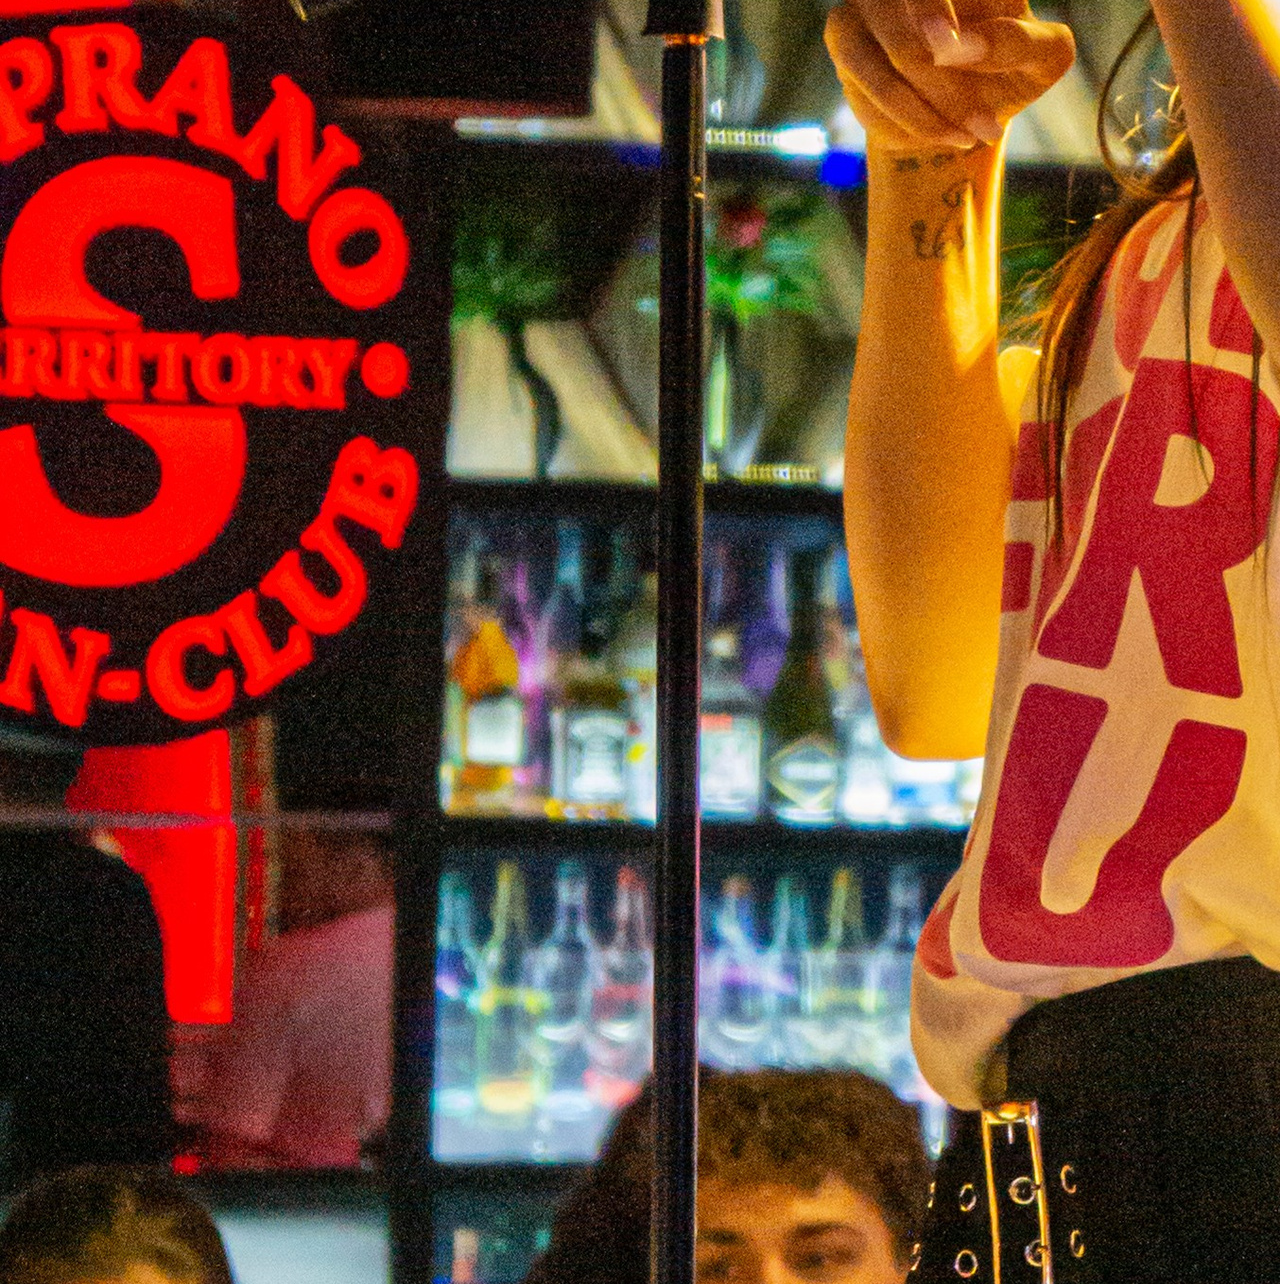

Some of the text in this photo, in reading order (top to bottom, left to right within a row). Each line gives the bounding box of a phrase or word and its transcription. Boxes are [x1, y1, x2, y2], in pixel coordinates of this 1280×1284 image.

[0, 21, 410, 310] PRANO
[0, 327, 358, 411] RRITORY
[0, 154, 247, 588] S
[0, 435, 420, 728] N-CLUB
